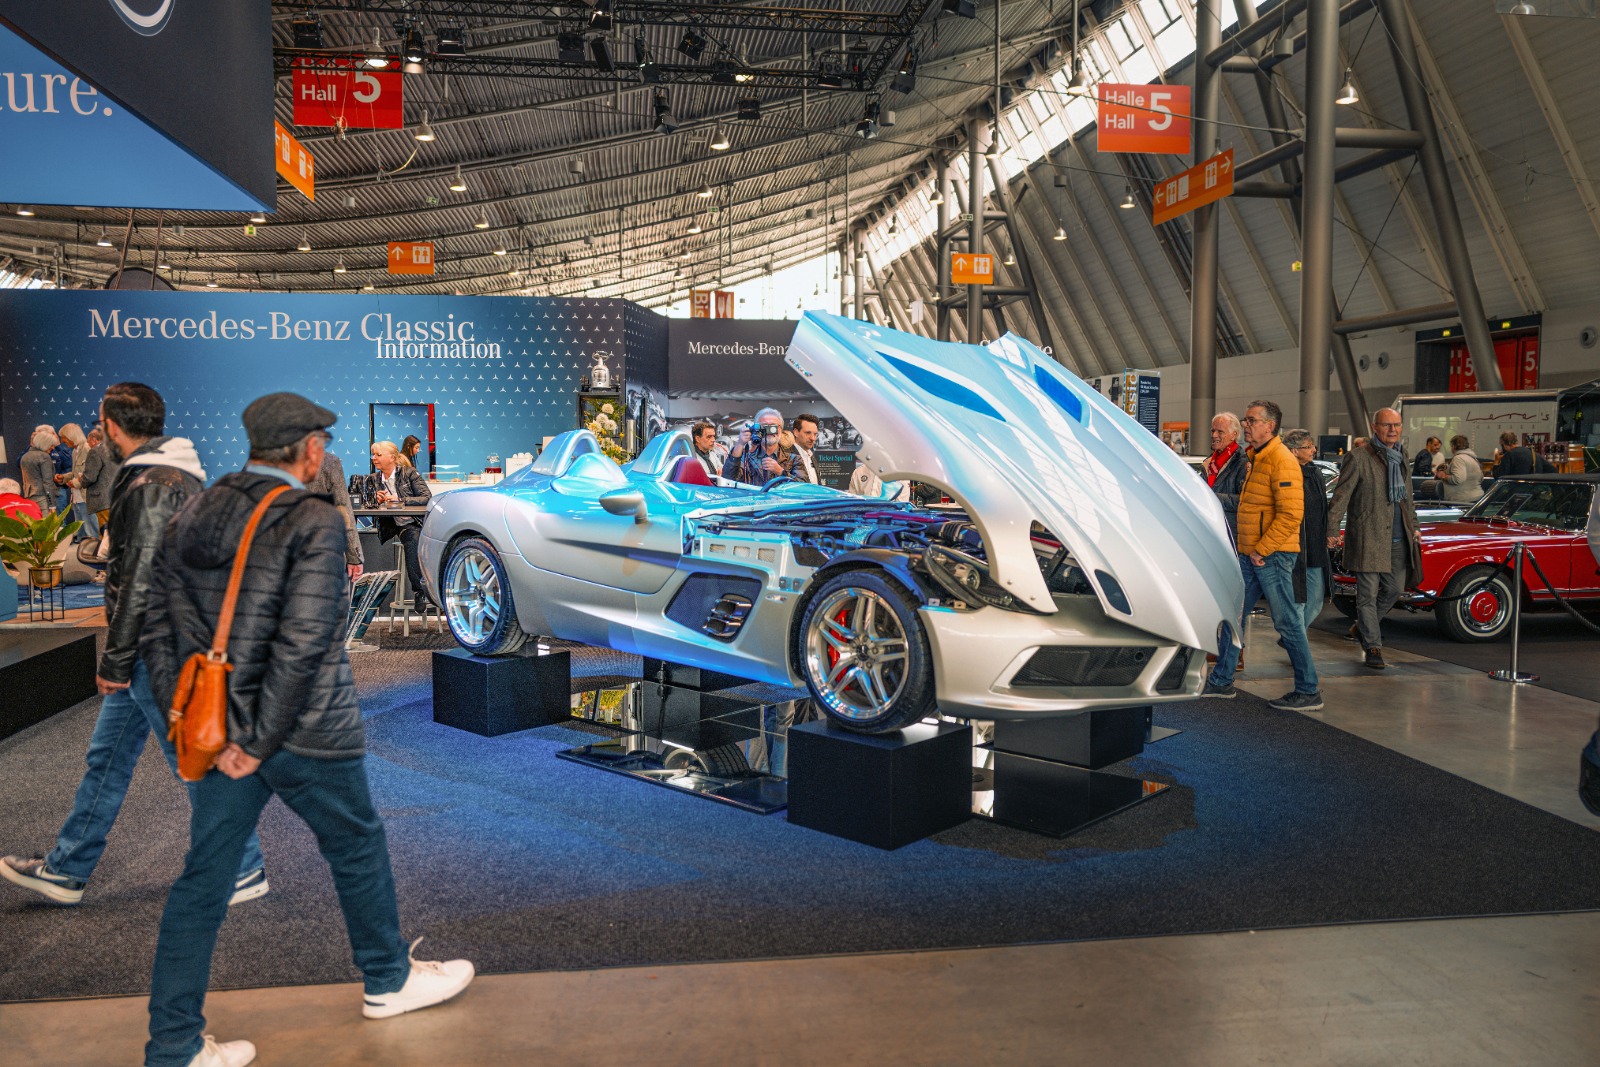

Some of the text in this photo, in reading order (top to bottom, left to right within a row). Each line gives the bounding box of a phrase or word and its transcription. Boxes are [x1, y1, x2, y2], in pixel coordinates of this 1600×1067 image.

[301, 84, 337, 102] Hall
[352, 60, 382, 104] 5
[0, 72, 113, 117] ure.
[1105, 90, 1145, 107] Halle
[1105, 113, 1135, 129] Hall
[1147, 92, 1173, 131] 5
[88, 308, 474, 342] Mercedes-Benz Classic
[376, 336, 502, 359] Information
[1524, 350, 1536, 372] 5
[834, 454, 853, 462] Special
